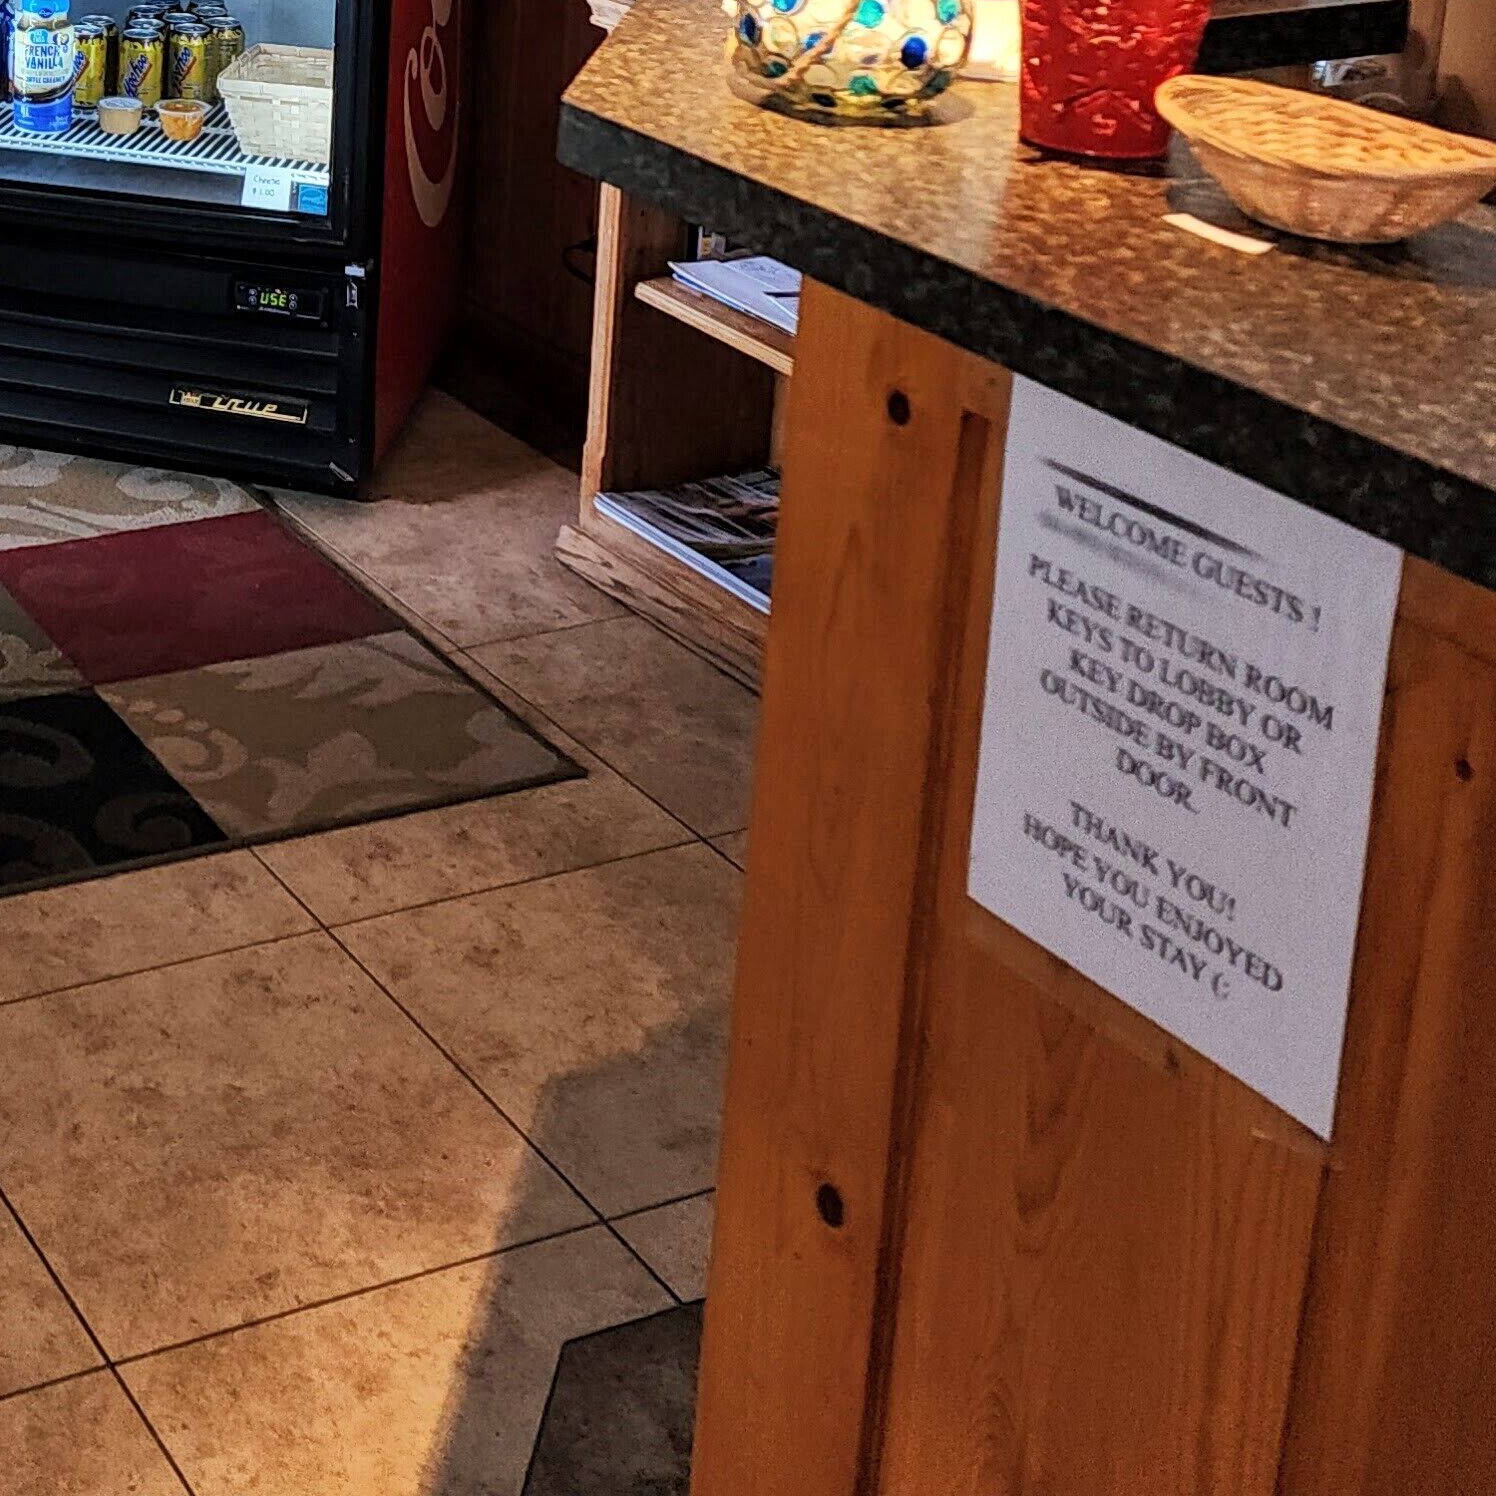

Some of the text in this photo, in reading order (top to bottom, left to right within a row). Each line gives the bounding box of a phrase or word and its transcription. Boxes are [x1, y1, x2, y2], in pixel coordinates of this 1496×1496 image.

[25, 57, 64, 70] VANILLA
[1055, 484, 1188, 568] WELCOME
[1028, 553, 1335, 731] PLEASE RETURN ROOM
[1047, 598, 1303, 755] KEYS TO LOBBY OR
[1039, 667, 1297, 829] OUTSIDE BY FRONT
[1070, 649, 1266, 775] KEY DROP BOX
[1022, 811, 1284, 992] HOPE YOU ENJOYED
[1071, 800, 1236, 921] THANK YOU!
[1062, 871, 1208, 982] YOUR STAY
